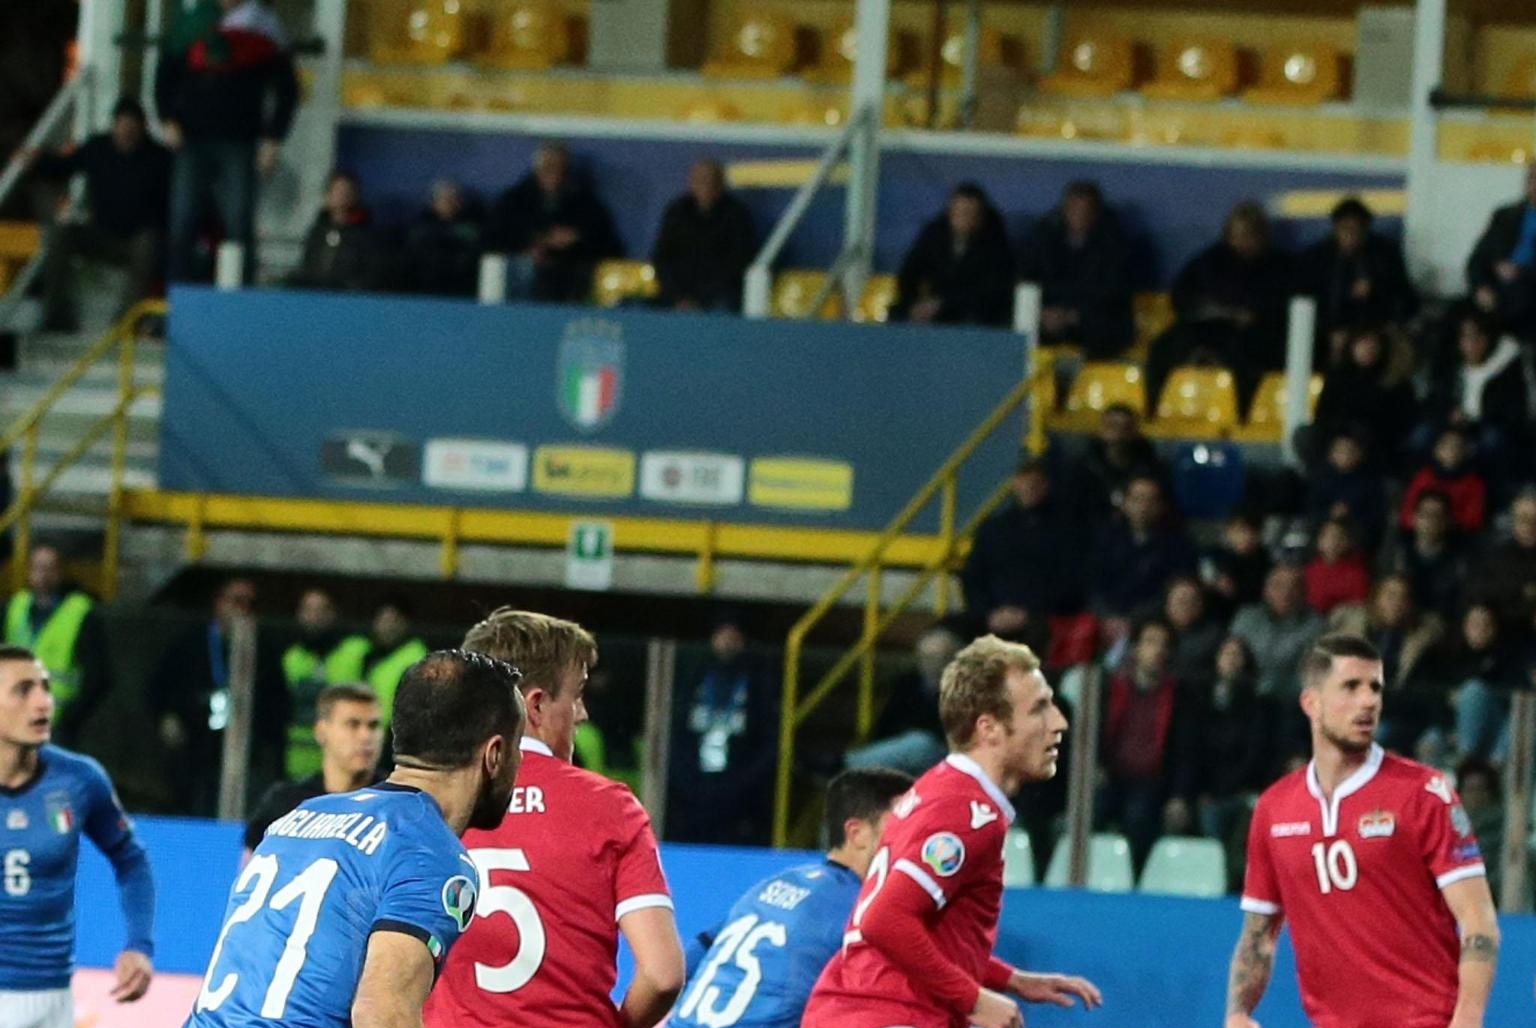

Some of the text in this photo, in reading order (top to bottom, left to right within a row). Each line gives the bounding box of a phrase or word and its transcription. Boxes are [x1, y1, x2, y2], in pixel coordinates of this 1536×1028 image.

[509, 786, 546, 813] ER
[4, 849, 31, 896] 6
[1311, 839, 1359, 895] 10
[197, 853, 339, 1020] 21
[466, 847, 547, 993] 5
